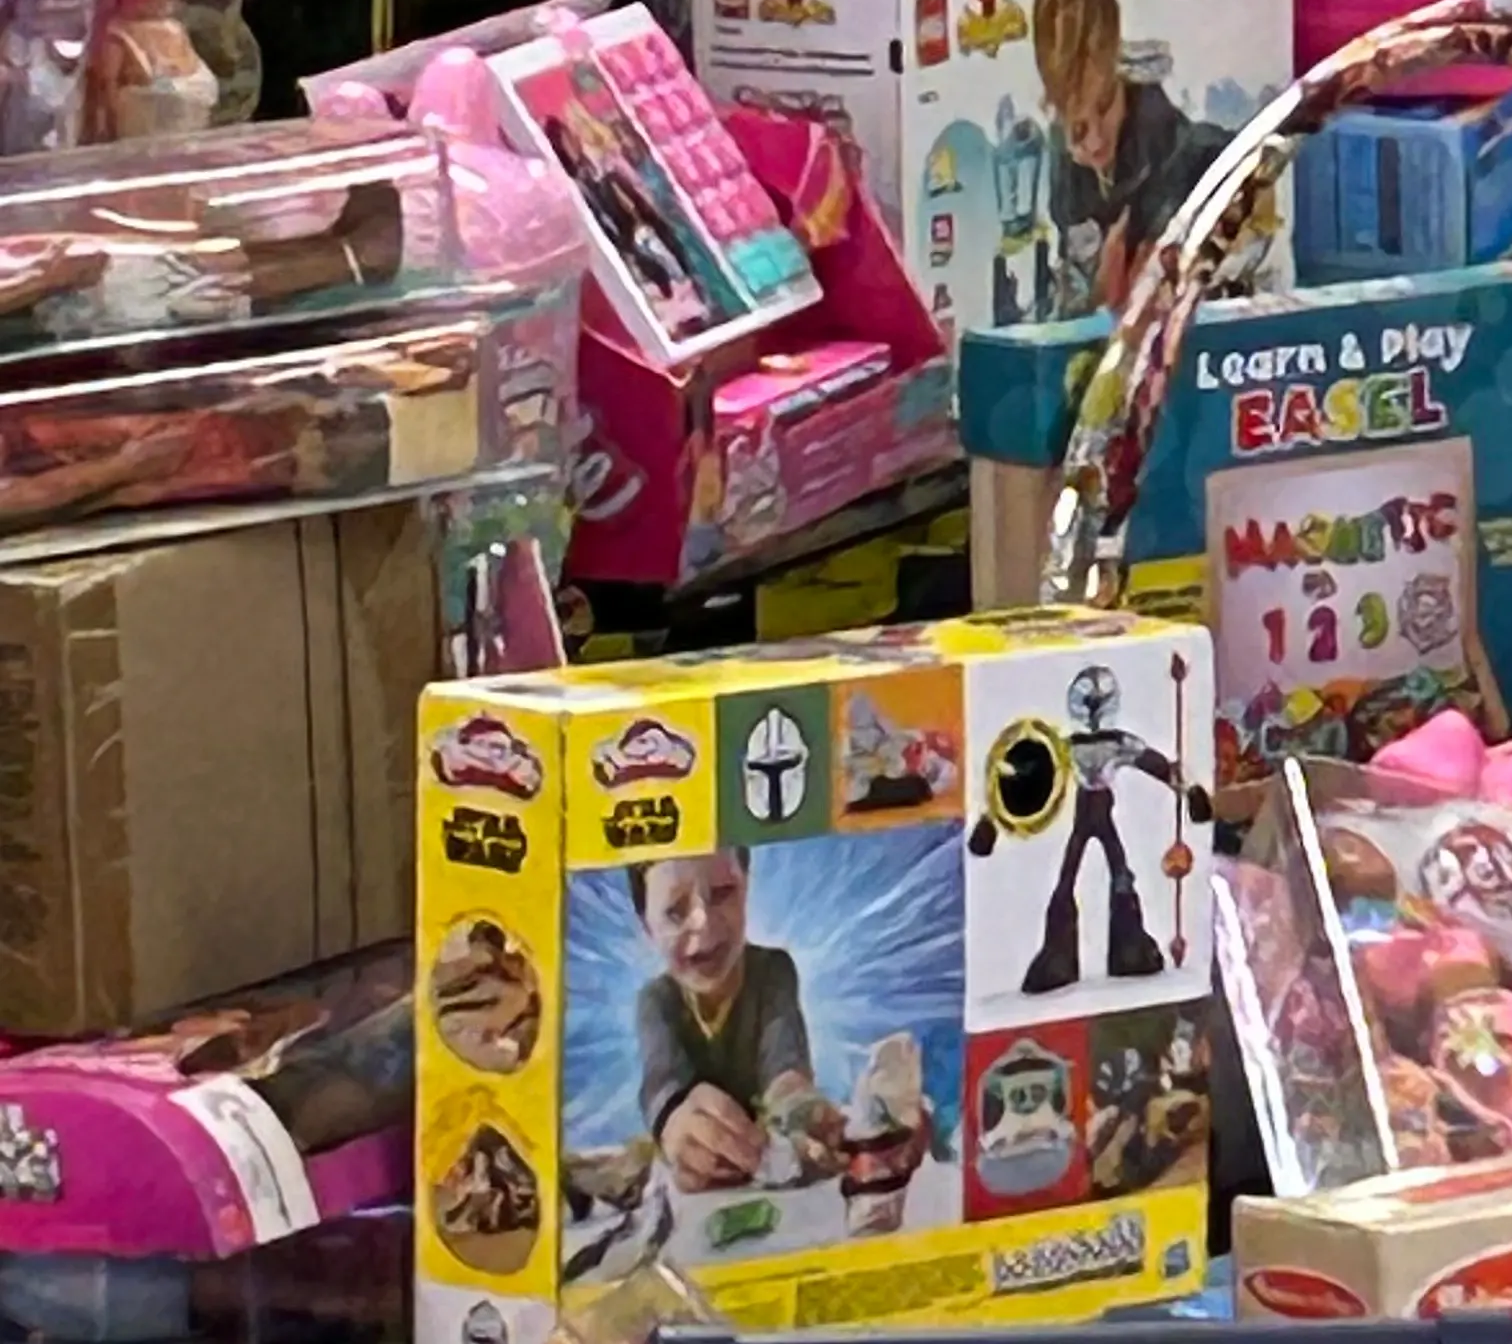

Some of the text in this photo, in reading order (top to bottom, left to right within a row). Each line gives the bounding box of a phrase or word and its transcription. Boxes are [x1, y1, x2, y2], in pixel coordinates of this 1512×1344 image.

[1196, 322, 1476, 390] Learn & Play
[1231, 365, 1450, 459] EASEL
